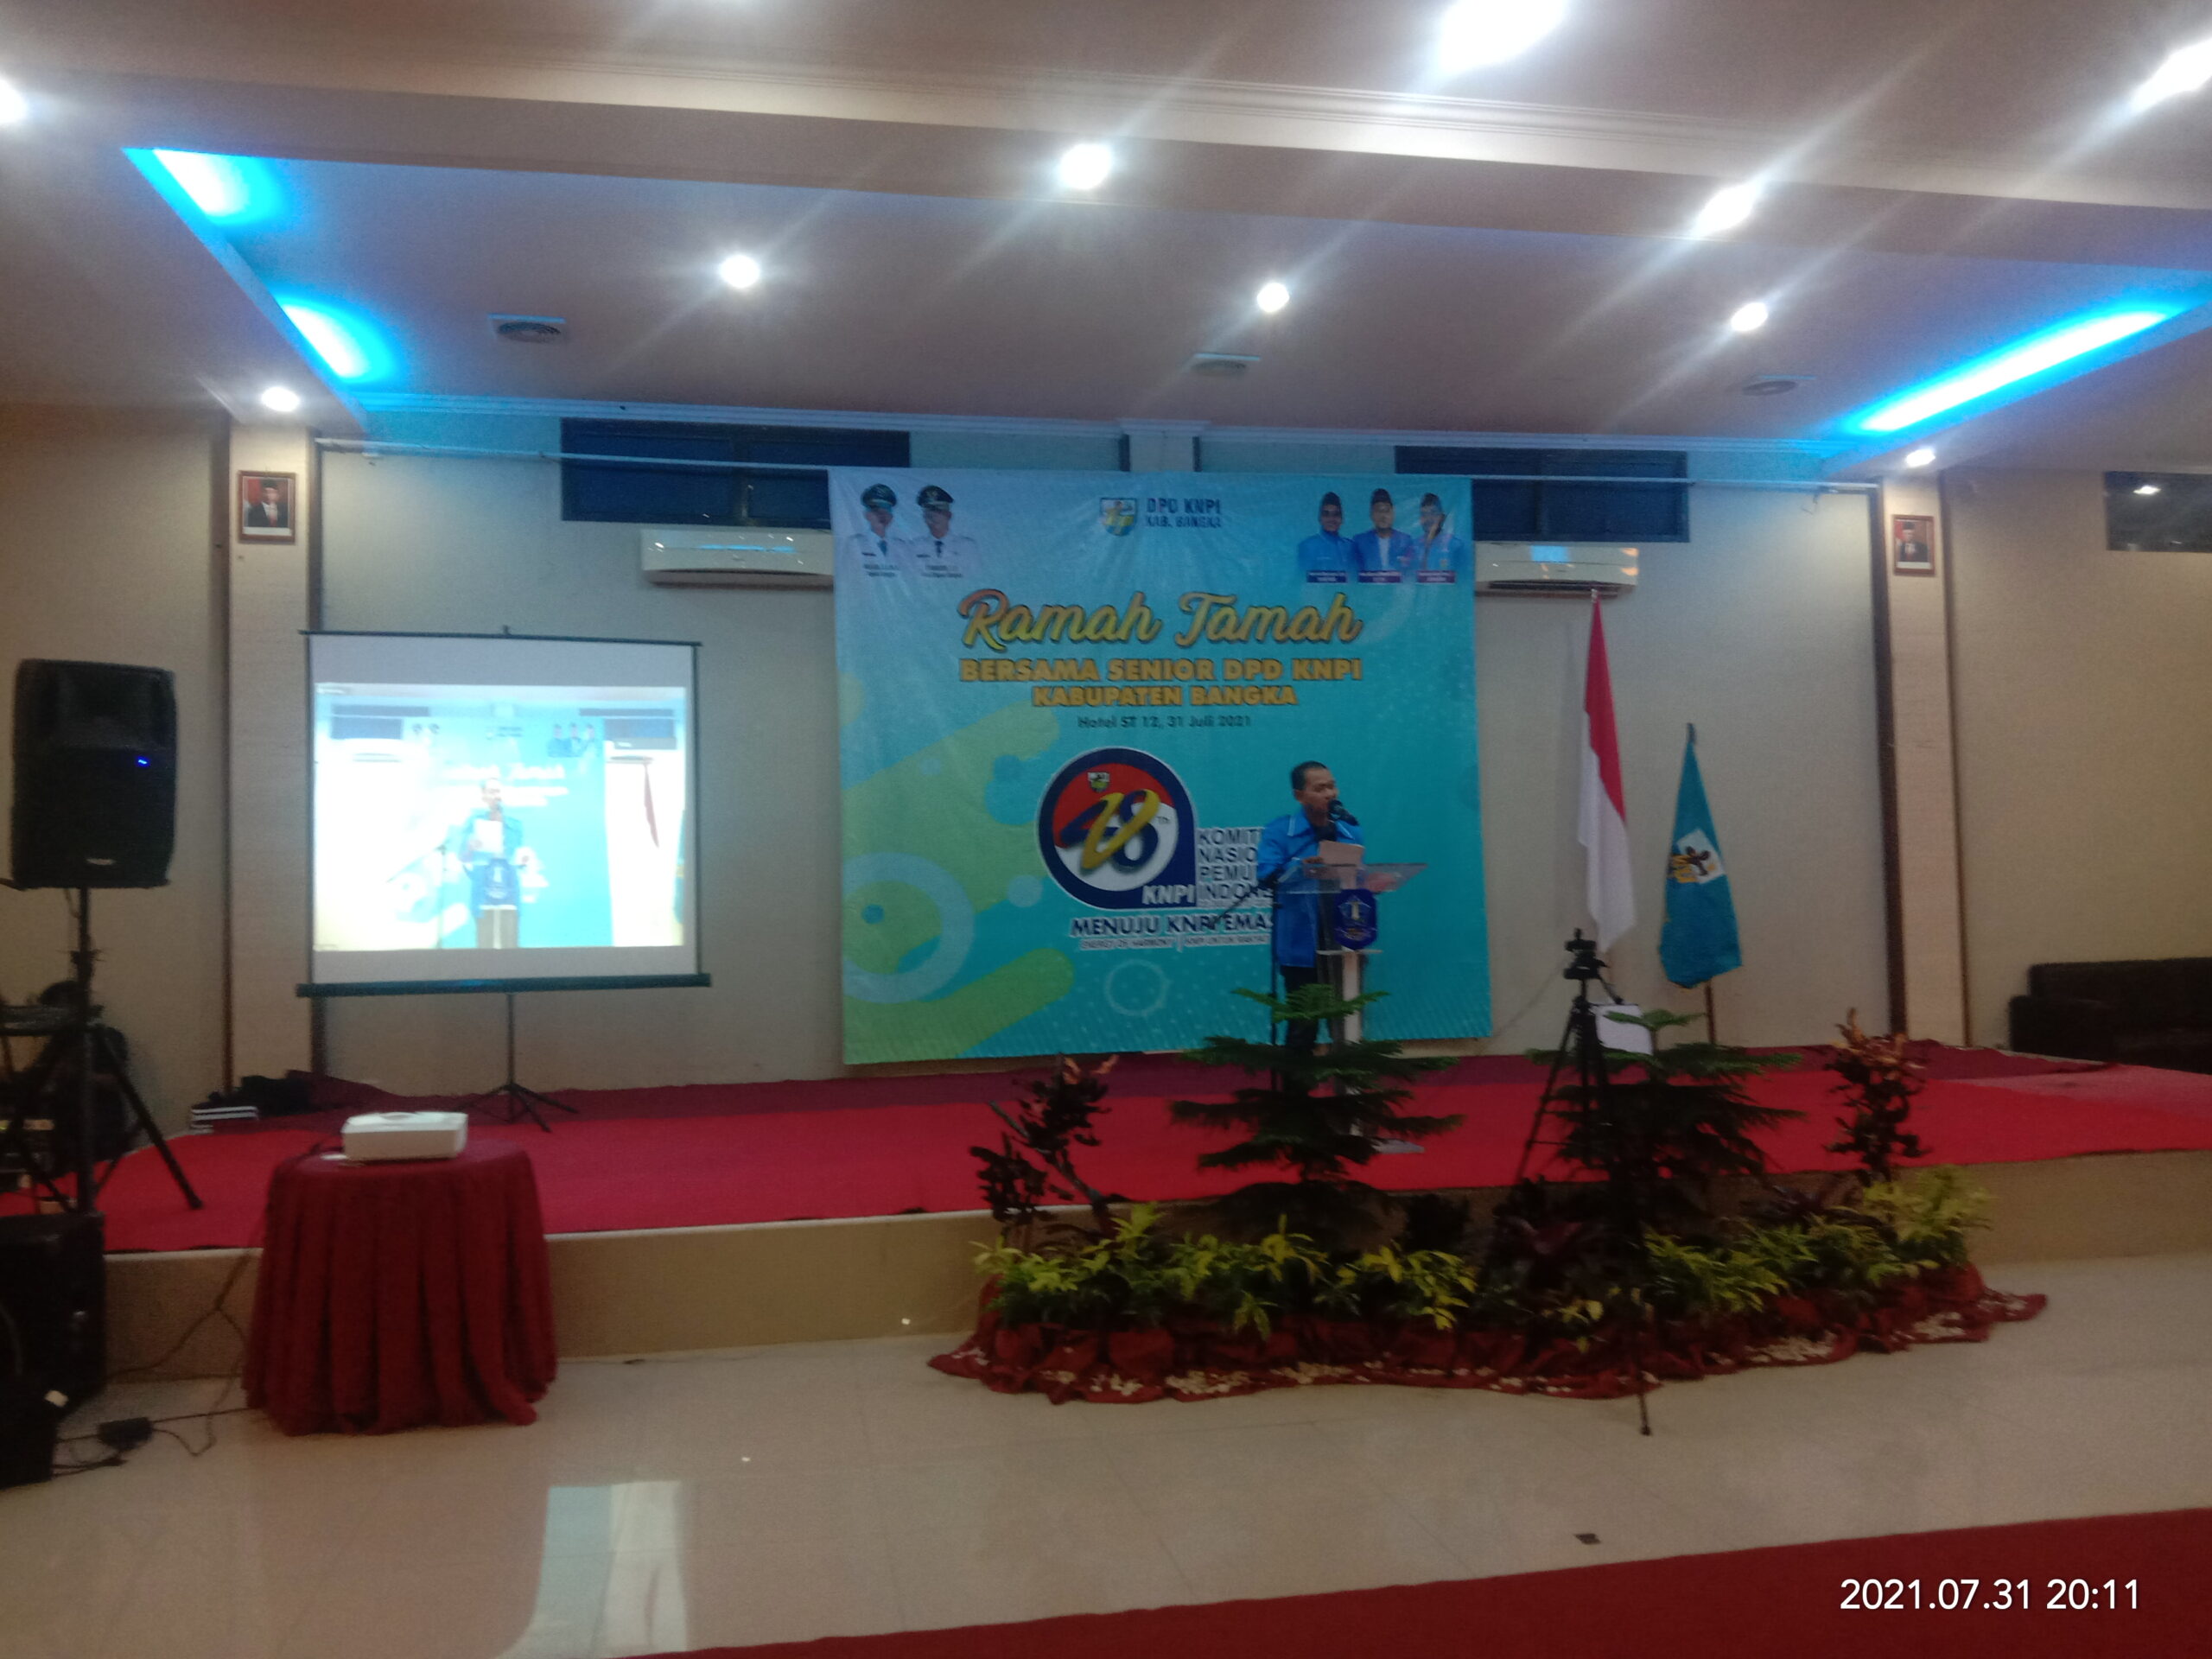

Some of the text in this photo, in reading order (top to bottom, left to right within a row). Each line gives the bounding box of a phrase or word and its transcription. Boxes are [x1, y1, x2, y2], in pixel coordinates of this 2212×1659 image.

[1146, 497, 1221, 514] DPD KNPI
[958, 588, 1363, 652] Ramah Tamah
[959, 658, 1363, 681] BERSAMA SENIOR DPD KNPI
[1033, 685, 1299, 707] KABUPATEN BANGKA
[1077, 715, 1252, 728] Hotel ST 12, 31 Juli 2021
[1198, 829, 1262, 844] KOMIT
[1198, 846, 1258, 862] NASIO
[1198, 865, 1254, 881] PEMU
[1142, 884, 1196, 905] KNPI
[1071, 917, 1160, 936] MENUJU
[1224, 913, 1271, 931] EMA
